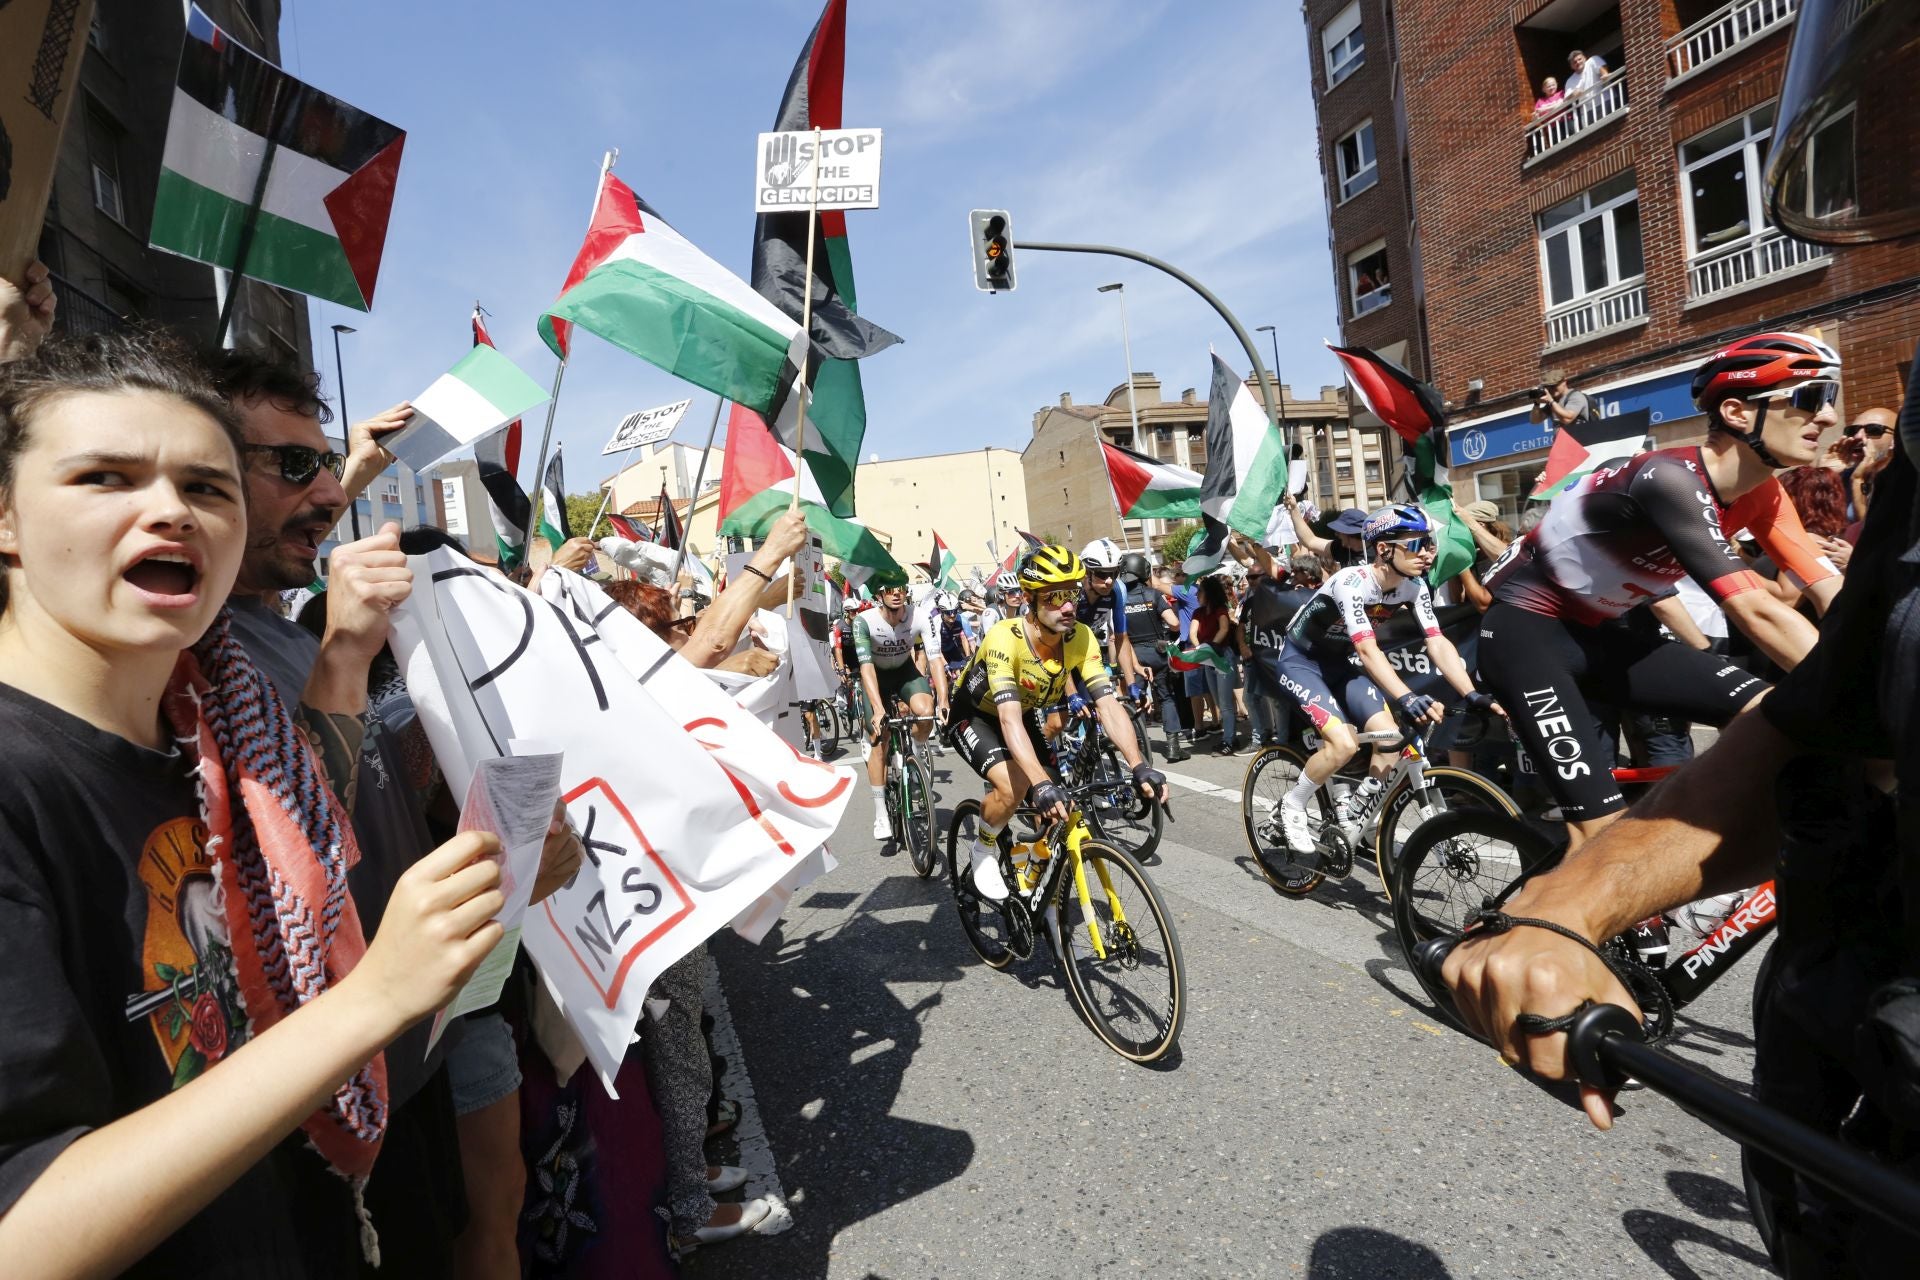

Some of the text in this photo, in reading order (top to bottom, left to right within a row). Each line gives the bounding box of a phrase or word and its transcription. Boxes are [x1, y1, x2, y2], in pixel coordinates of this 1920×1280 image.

[799, 134, 876, 160] STOP
[816, 166, 850, 178] THE
[762, 187, 872, 204] GENOCIDE
[1728, 370, 1757, 380] INEOS
[641, 402, 686, 424] STOP
[609, 430, 669, 449] GENOCIDE
[1696, 490, 1741, 561] INEOS
[1292, 600, 1327, 636] hansgrohe
[1352, 595, 1367, 625] BOSS
[1420, 593, 1435, 621] BOSS
[1254, 625, 1271, 647] La
[988, 649, 1010, 663] VISMA
[1280, 674, 1311, 701] BORA
[1524, 686, 1591, 780] INEOS
[1252, 751, 1279, 773] roval
